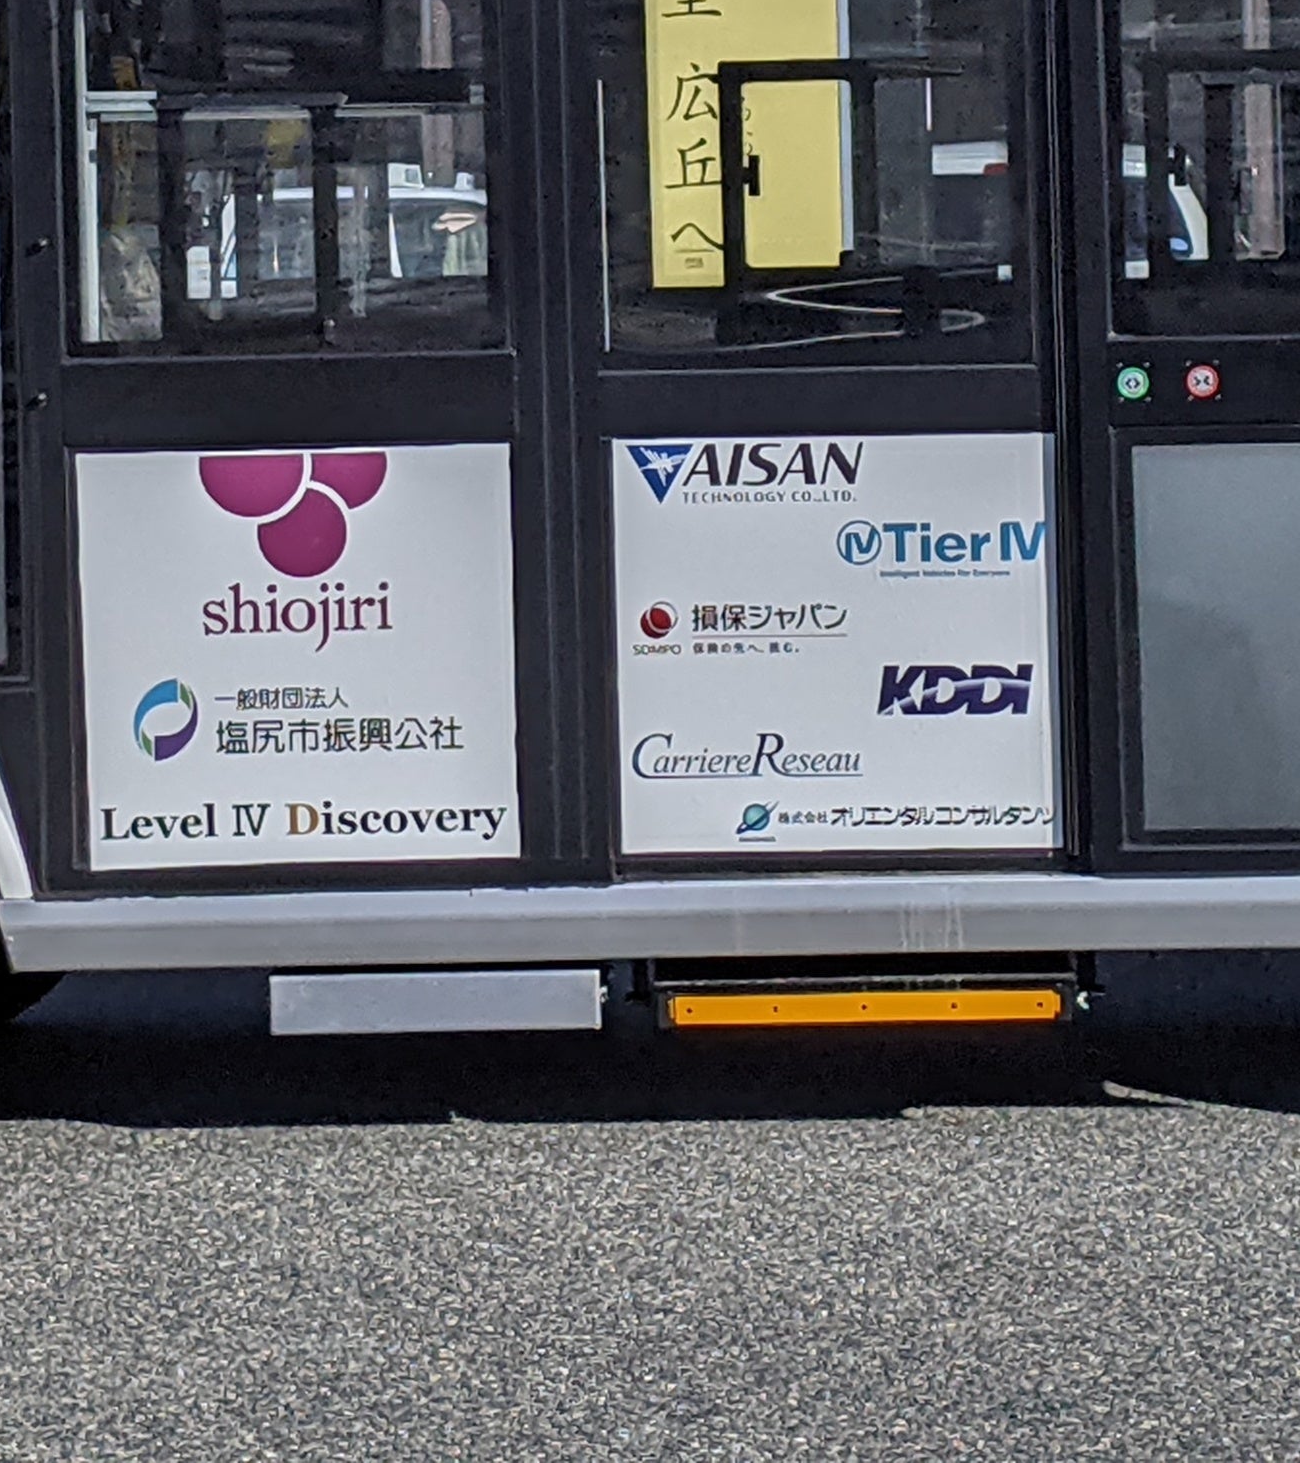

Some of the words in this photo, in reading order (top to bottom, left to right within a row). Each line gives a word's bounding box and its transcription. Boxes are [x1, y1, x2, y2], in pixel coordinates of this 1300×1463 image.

[682, 441, 863, 487] AISAN
[682, 490, 787, 504] TECHNOLOGY
[882, 523, 992, 563] Tier
[203, 582, 394, 653] shiojiri
[692, 603, 848, 632] 損保ジャパン
[214, 687, 349, 710] 一般財団法人
[877, 664, 1033, 715] KDDI
[101, 803, 217, 841] Level
[287, 801, 508, 841] Discovery
